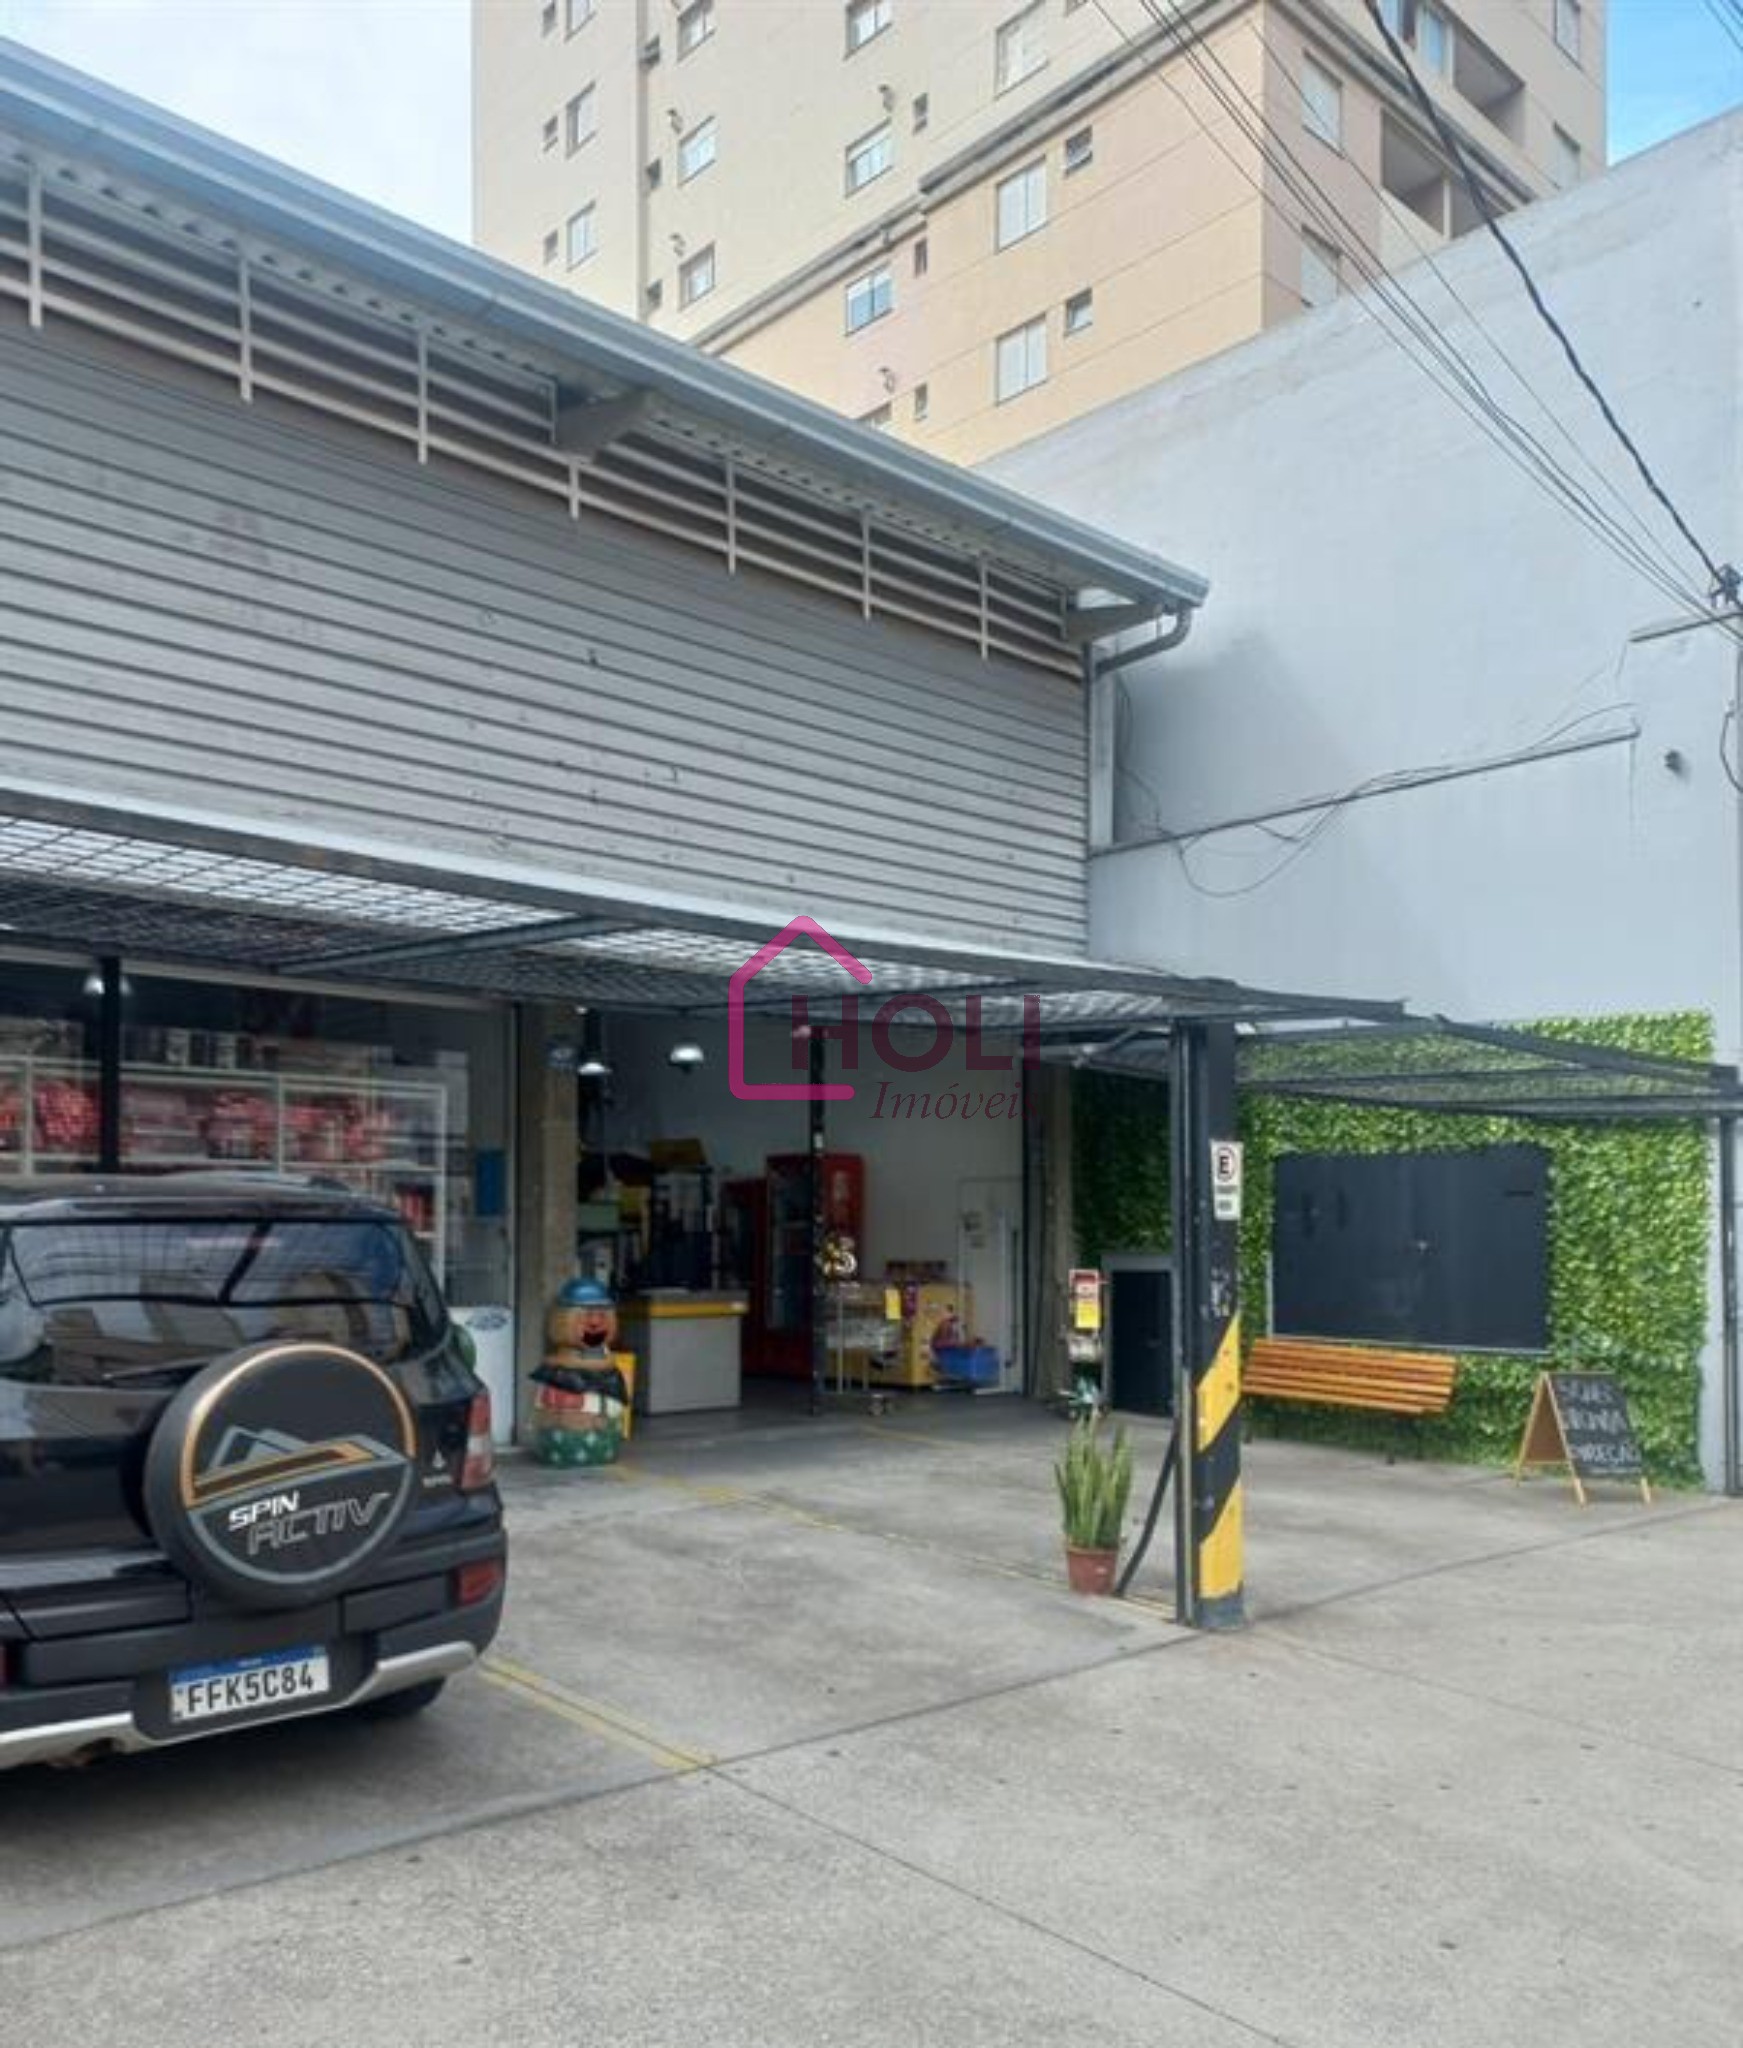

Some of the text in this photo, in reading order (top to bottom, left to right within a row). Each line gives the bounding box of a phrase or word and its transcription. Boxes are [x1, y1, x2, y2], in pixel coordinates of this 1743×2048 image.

[1219, 1155, 1230, 1175] E
[228, 1489, 300, 1532] SPIN
[246, 1491, 392, 1556] ACTIV
[187, 1661, 314, 1713] FFK5C84
